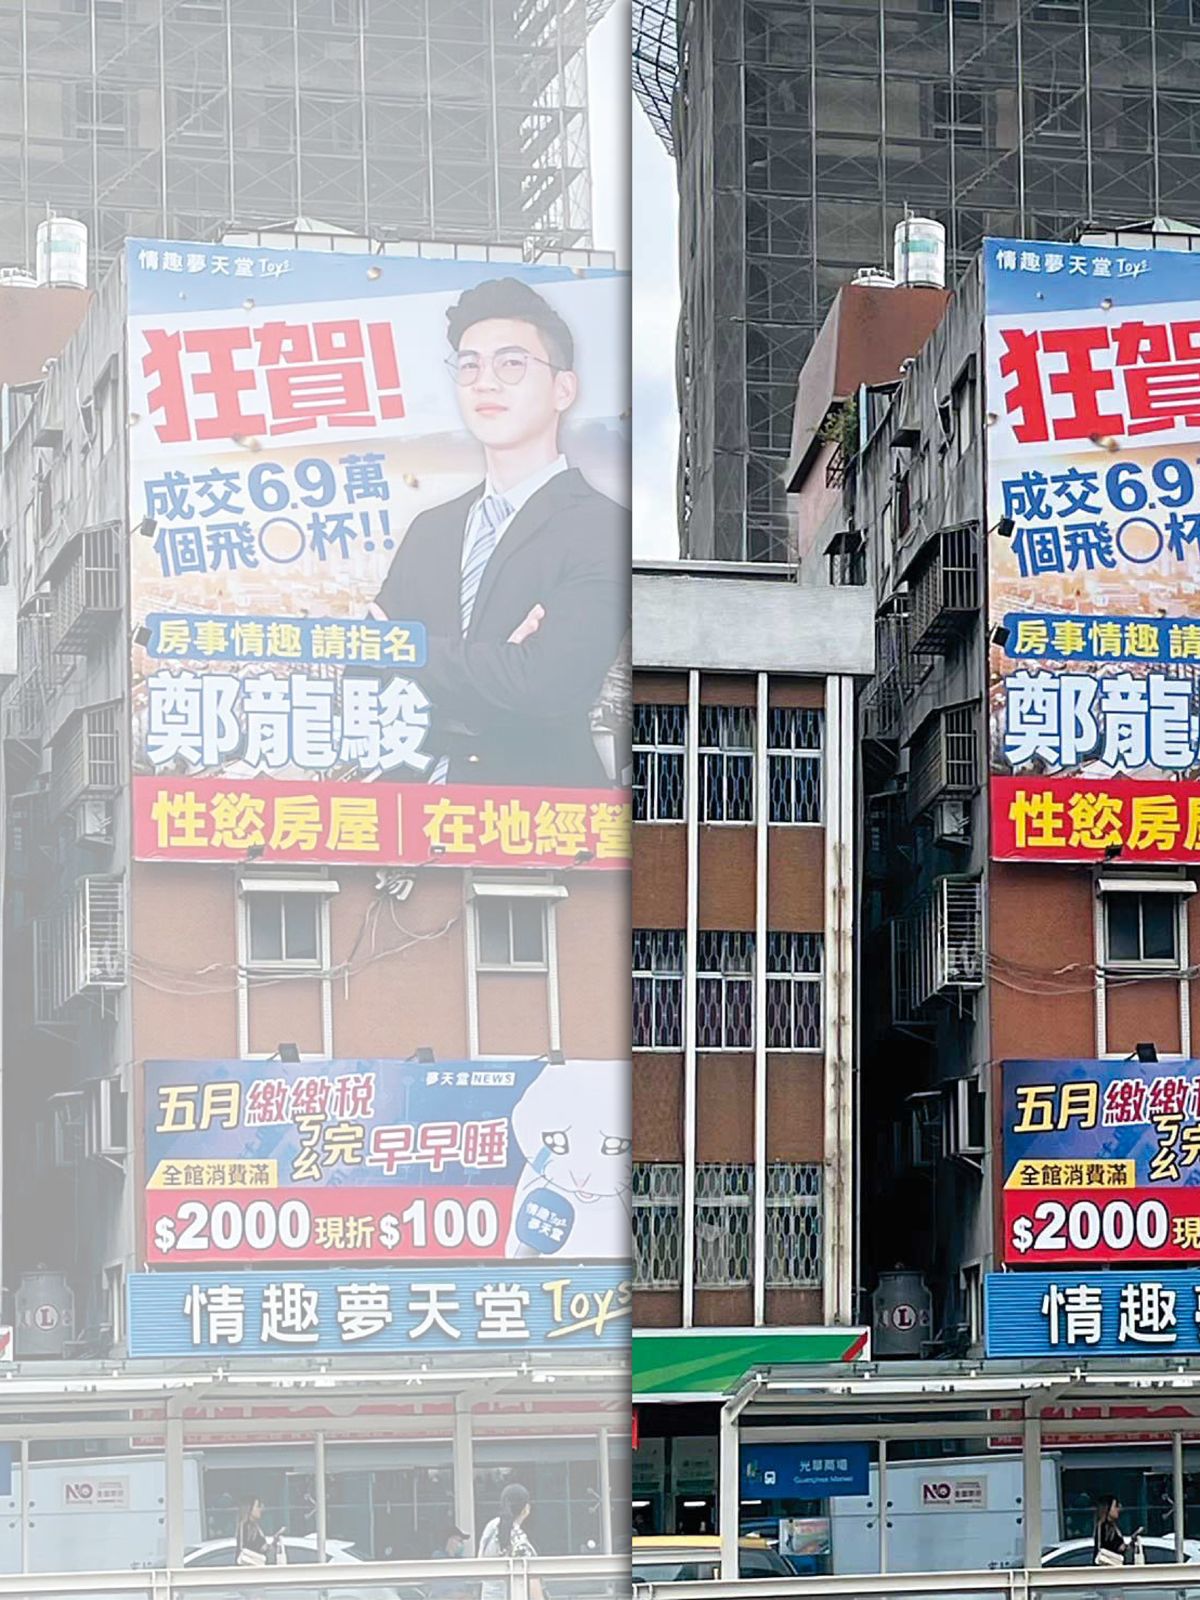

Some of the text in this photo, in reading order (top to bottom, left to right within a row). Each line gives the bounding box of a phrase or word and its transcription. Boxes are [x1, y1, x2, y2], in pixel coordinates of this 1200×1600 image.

[138, 250, 254, 277] 情趣夢天堂
[996, 250, 1152, 278] 情趣夢天堂 Toys
[142, 319, 406, 443] 狂賀!
[1013, 619, 1160, 659] 房事情趣
[146, 669, 432, 771] 鄭龍駿
[151, 790, 380, 852] 性慾房屋
[162, 1165, 269, 1187] 全館消費滿
[1020, 1165, 1127, 1187] 全館消費滿
[183, 1281, 530, 1345] 情趣夢天堂
